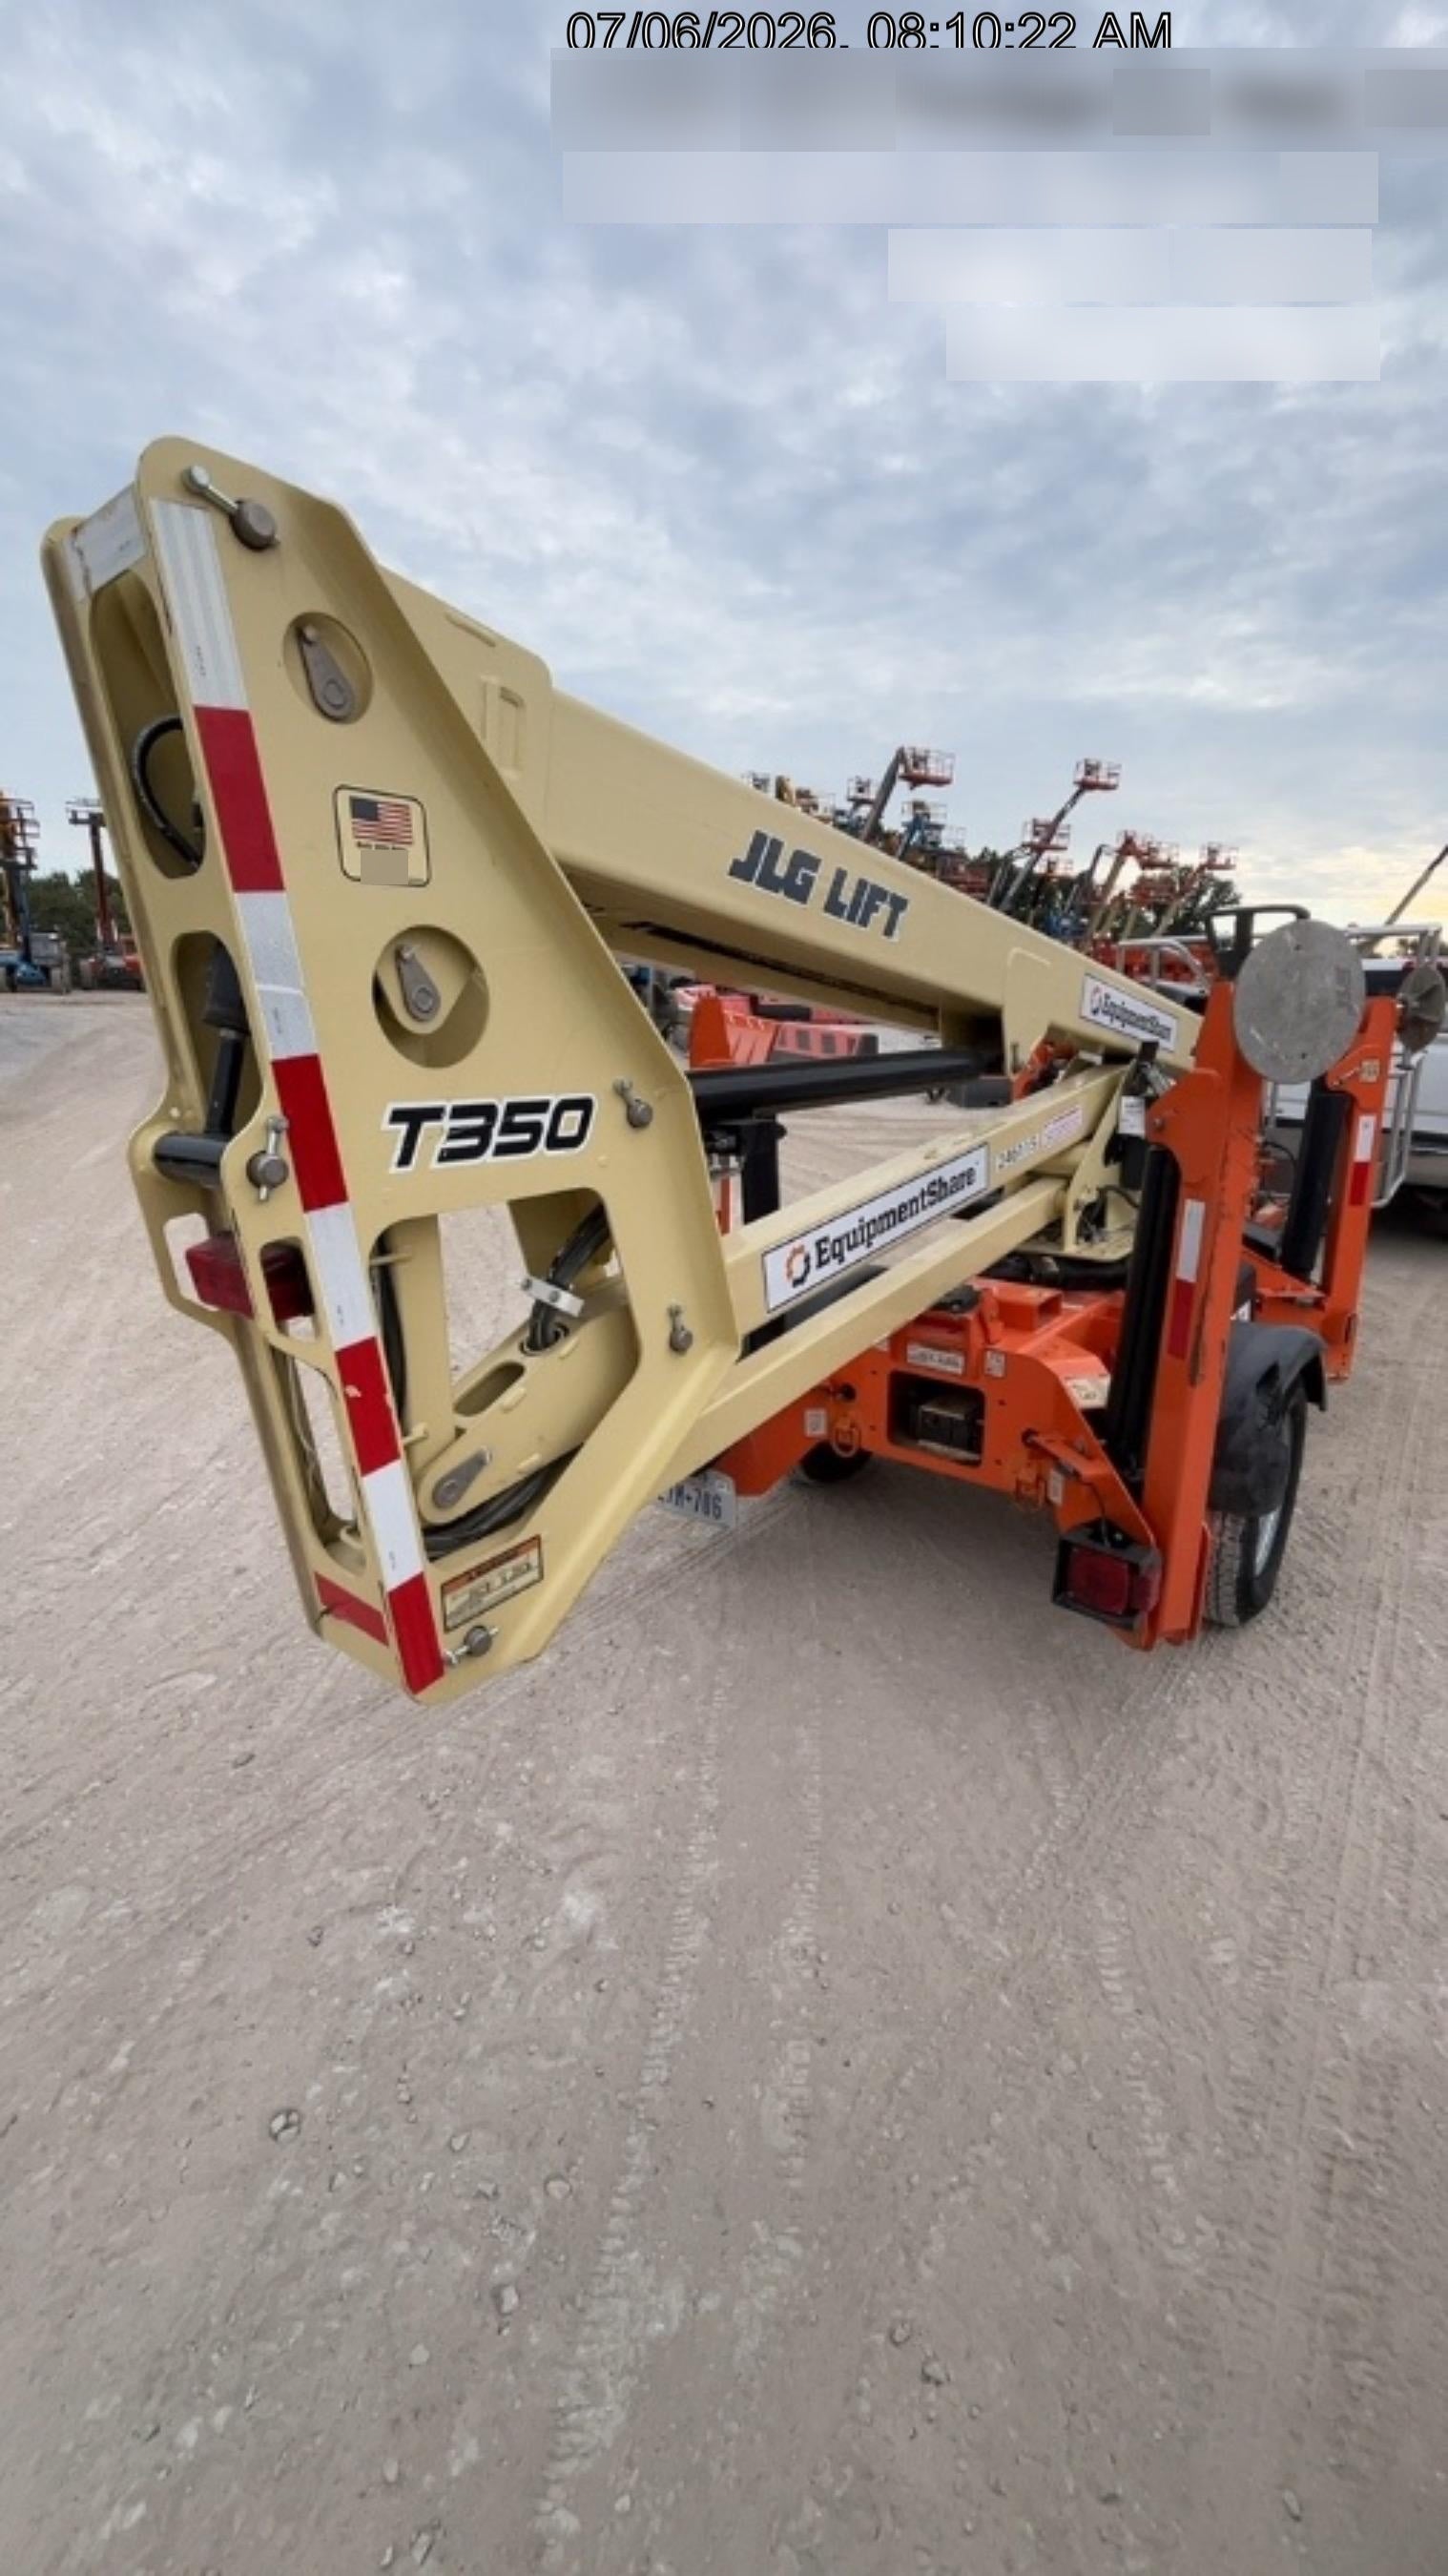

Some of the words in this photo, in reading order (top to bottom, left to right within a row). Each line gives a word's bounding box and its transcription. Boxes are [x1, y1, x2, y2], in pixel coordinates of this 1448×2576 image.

[729, 829, 821, 906] JLG
[823, 866, 910, 941] LIFT
[383, 1094, 596, 1173] T350
[815, 1166, 977, 1269] EquipmentShare
